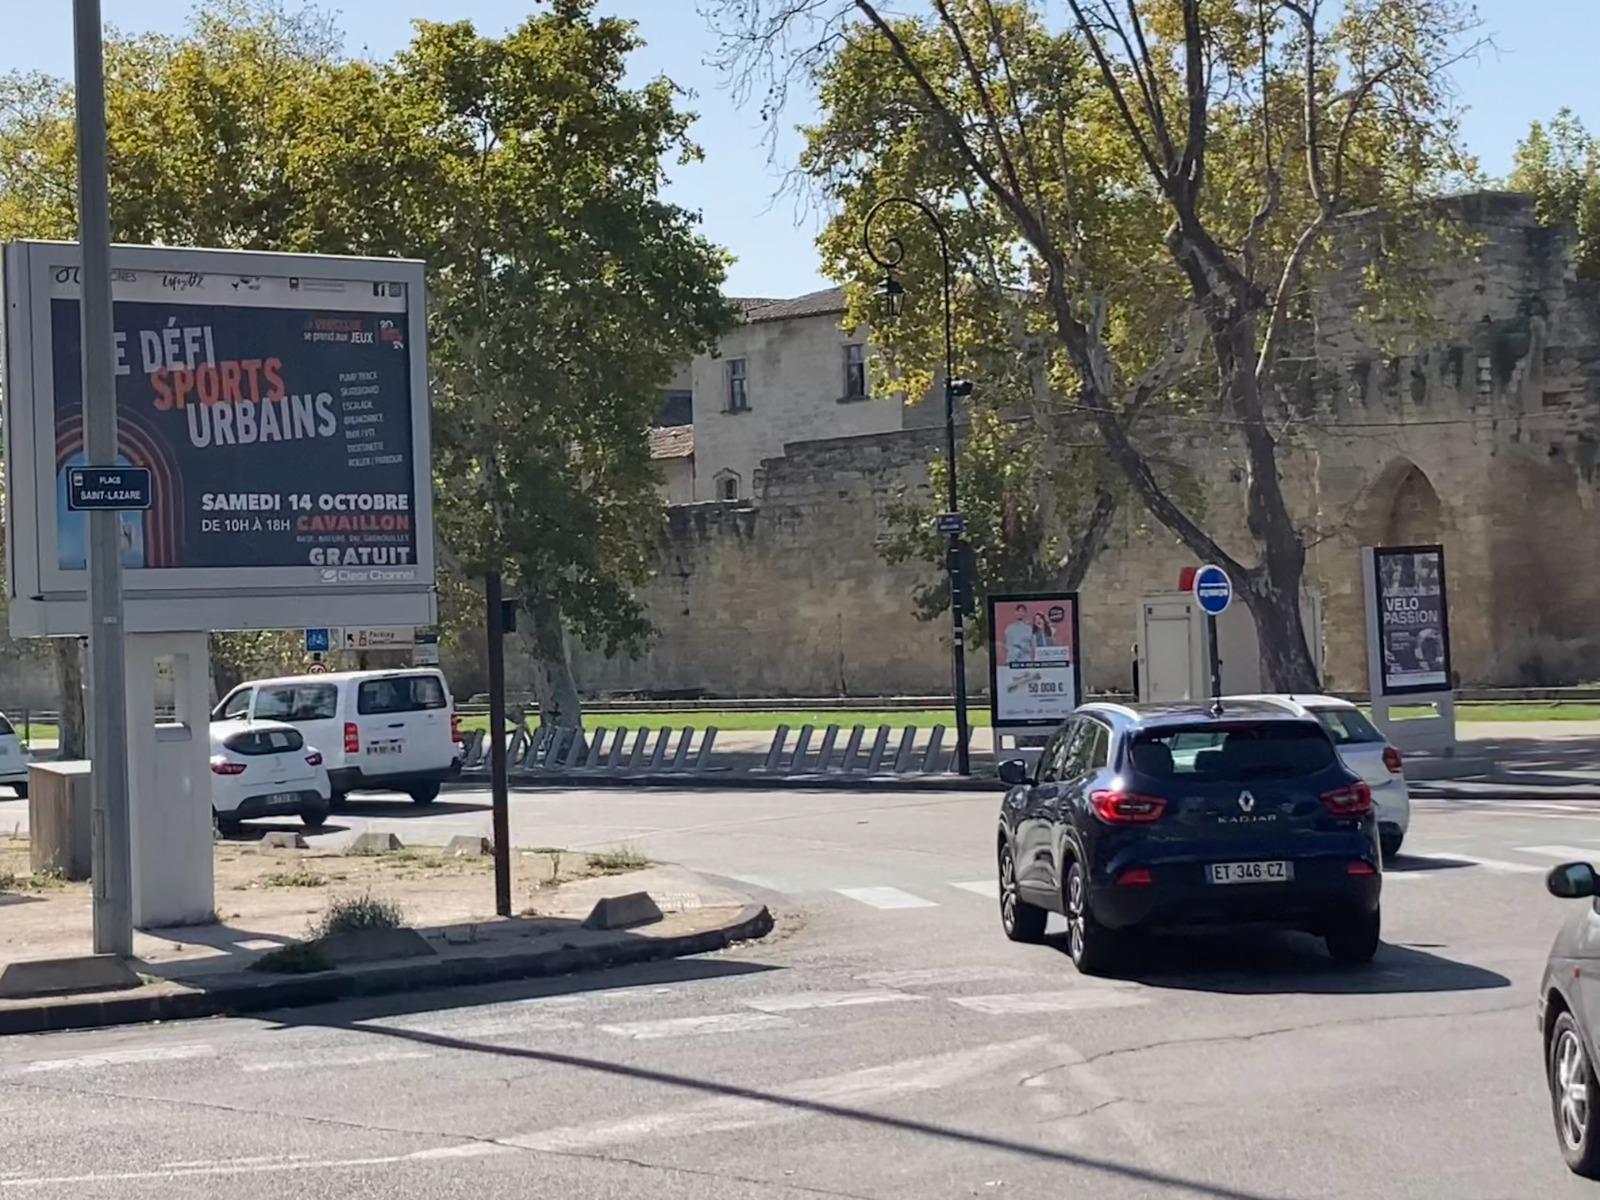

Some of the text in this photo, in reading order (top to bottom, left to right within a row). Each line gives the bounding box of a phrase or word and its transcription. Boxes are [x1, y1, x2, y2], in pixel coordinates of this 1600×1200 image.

[113, 316, 216, 375] E DÉFI
[350, 331, 374, 343] JEUX
[151, 357, 285, 411] SPORTS
[187, 392, 337, 448] URBAINS
[80, 490, 141, 500] SAINT-LAZARE
[201, 493, 409, 511] SAMEDI 14 OCTOBRE
[201, 515, 291, 532] DE 10H À 18H
[296, 514, 410, 531] CAVAILLON
[309, 546, 410, 566] GRATUIT
[338, 569, 414, 580] Clear Channel
[1384, 611, 1438, 624] PASSION
[1218, 815, 1276, 823] KADJAR
